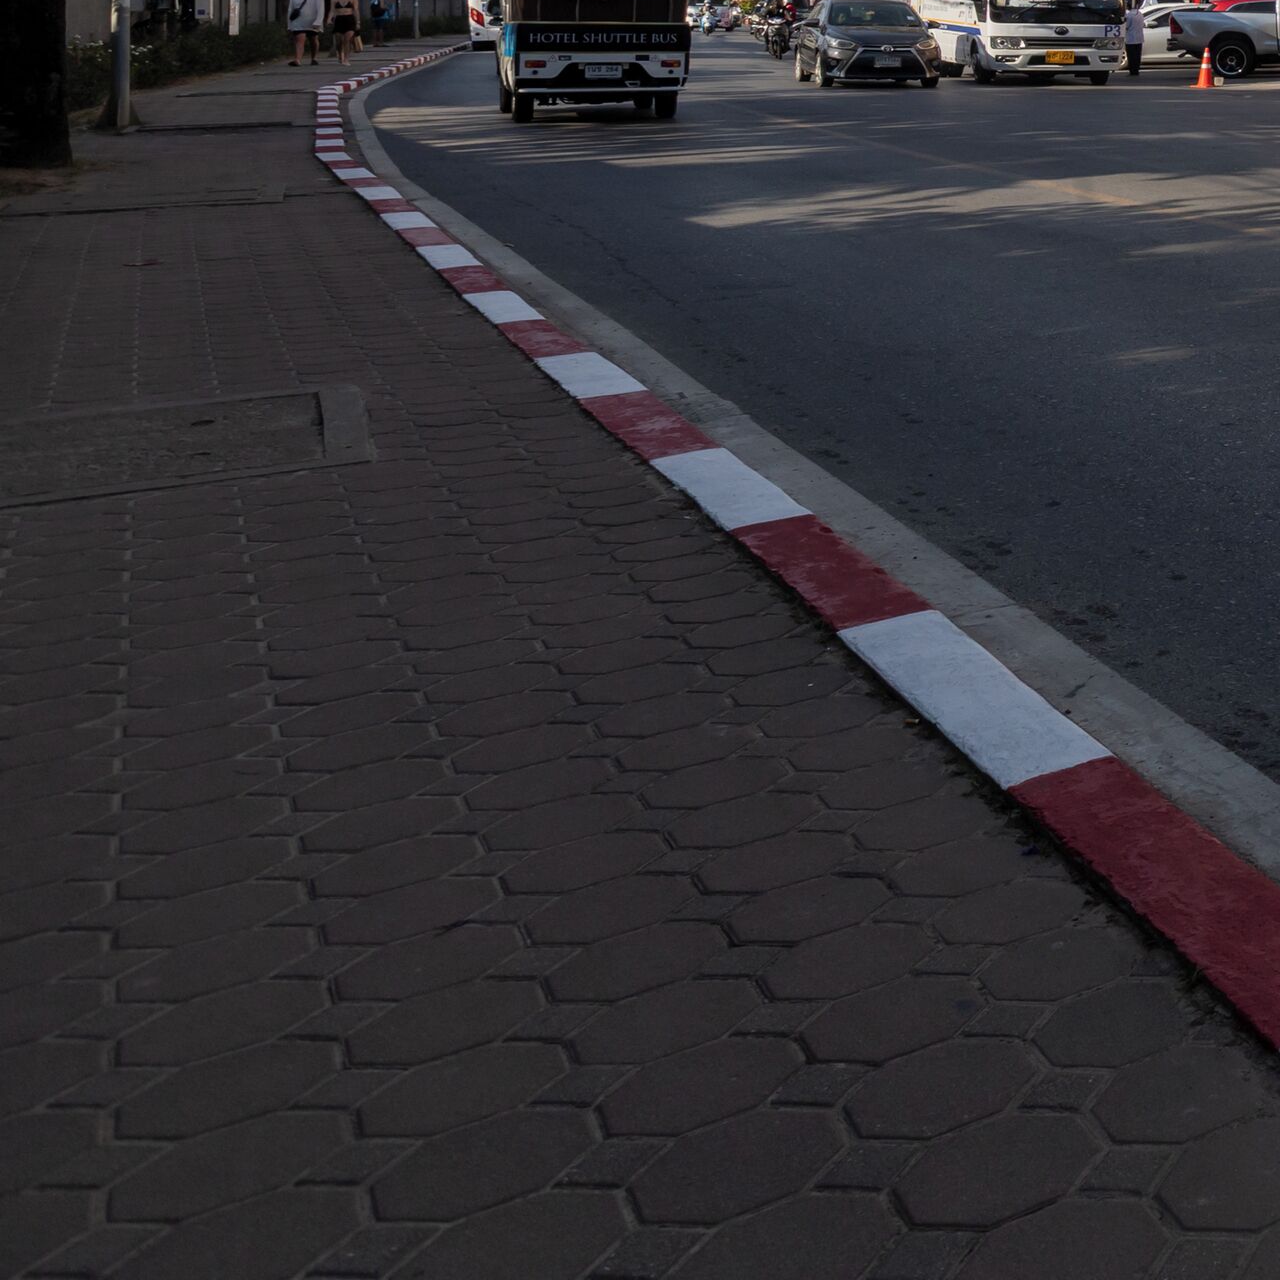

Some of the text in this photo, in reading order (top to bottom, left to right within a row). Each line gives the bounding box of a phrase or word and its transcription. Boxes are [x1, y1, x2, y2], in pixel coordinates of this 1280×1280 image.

[1104, 25, 1120, 37] P3
[529, 33, 678, 44] HOTEL SHUTTLE BUS
